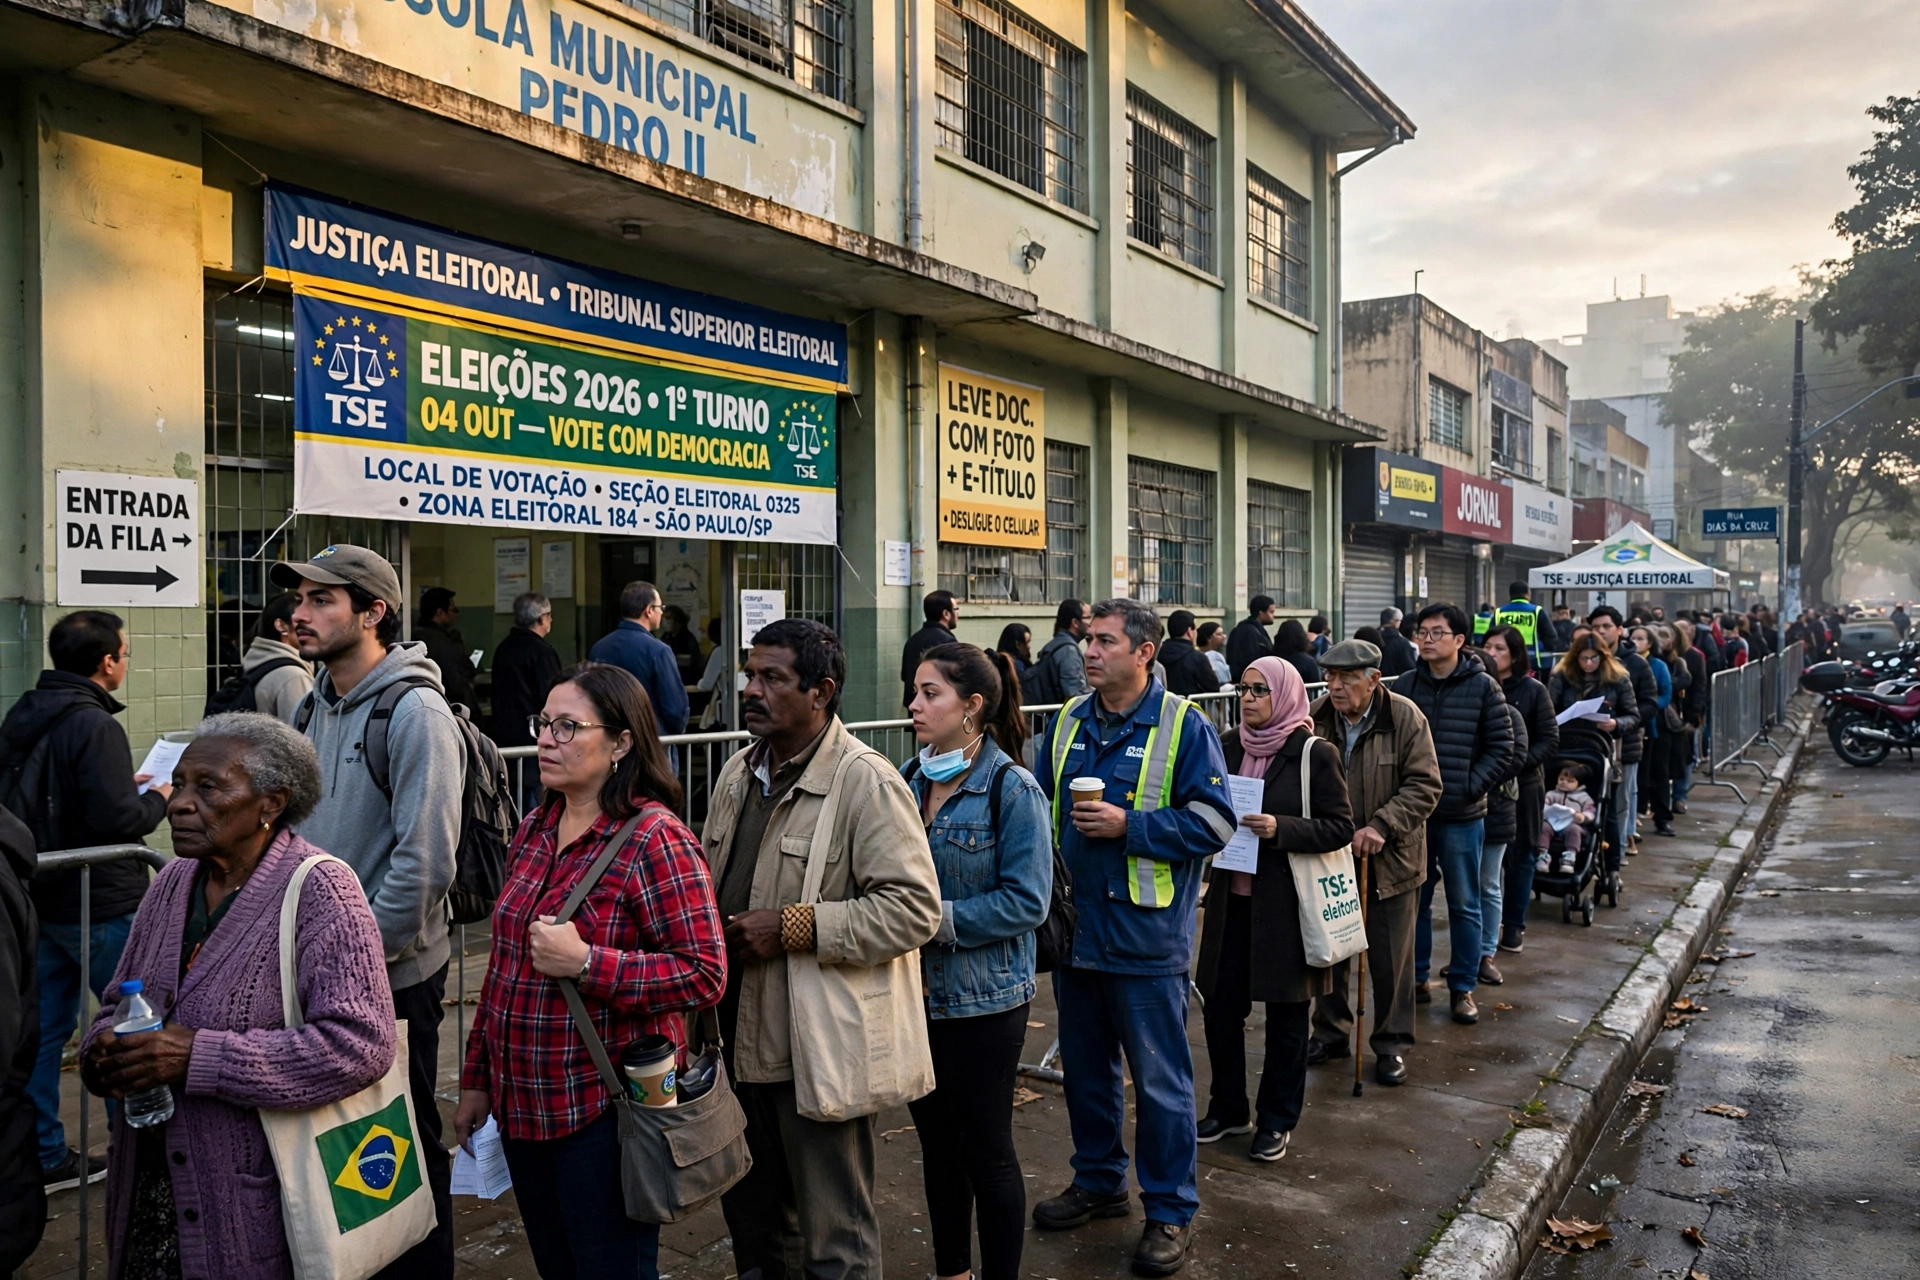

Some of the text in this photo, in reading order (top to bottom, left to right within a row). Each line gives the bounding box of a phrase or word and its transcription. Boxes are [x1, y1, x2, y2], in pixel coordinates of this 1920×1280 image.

[550, 9, 757, 145] MUNICIPAL
[520, 66, 705, 178] PEDRO II
[289, 214, 839, 367] JUSTIÇA ELEITORAL TRIBUNAL SUPERIOR ELEITORAL
[420, 340, 568, 405] ELEIÇÕES
[573, 368, 642, 417] 2026
[692, 388, 770, 435] TURNO
[947, 380, 1034, 428] LEVE DOC.
[325, 392, 387, 430] TSE
[420, 396, 459, 433] 04
[463, 402, 515, 441] OUT
[548, 415, 604, 452] VOTE
[608, 424, 653, 457] COM
[656, 429, 771, 471] DEMOCRACIA
[948, 420, 1035, 464] COM FOTO
[364, 456, 800, 515] LOCAL DE VOTAÇÃO SEÇÃO ELEITORAL 0325
[793, 464, 819, 480] TSE
[963, 459, 1036, 500] E-TÍTULO
[67, 486, 190, 519] ENTRADA
[418, 491, 485, 519] ZONA
[491, 498, 602, 526] ELEITORAL
[607, 507, 638, 528] 184
[655, 507, 690, 532] SÃO
[696, 514, 772, 538] PAULO/SP
[950, 510, 1040, 537] DESLIGUE O CELULAR
[1457, 482, 1502, 529] JORNAL
[67, 522, 167, 552] DA FILA
[1706, 521, 1727, 533] DIAS
[1745, 521, 1769, 531] CRUZ
[1542, 573, 1563, 585] TSE
[1575, 573, 1623, 587] JUSTIÇA
[1627, 572, 1694, 585] ELEITORAL
[1317, 873, 1348, 898] TSE
